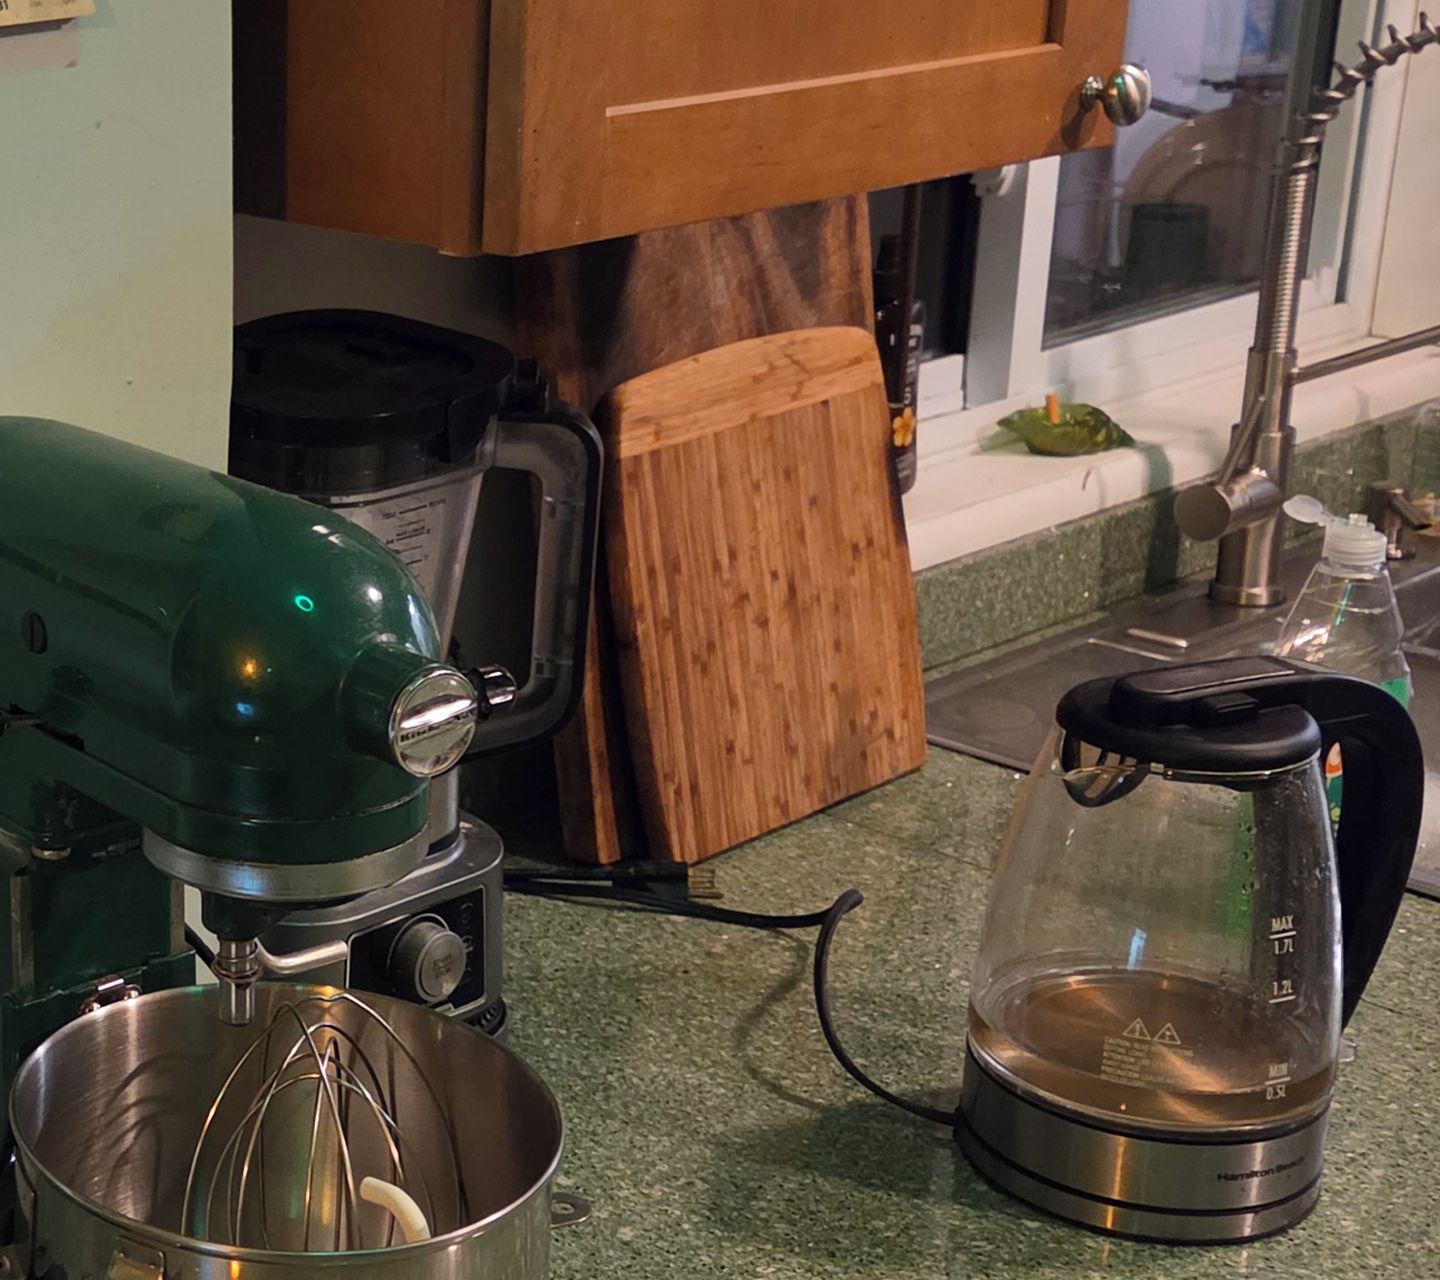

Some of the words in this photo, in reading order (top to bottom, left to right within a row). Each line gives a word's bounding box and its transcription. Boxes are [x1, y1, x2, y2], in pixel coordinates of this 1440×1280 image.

[1271, 915, 1294, 932] MAX
[1274, 939, 1294, 955] 1.7L
[1272, 979, 1293, 996] 1.2L
[1268, 1063, 1289, 1078] MIN
[1265, 1085, 1287, 1101] 0.5L
[1217, 1167, 1275, 1181] Hamilton
